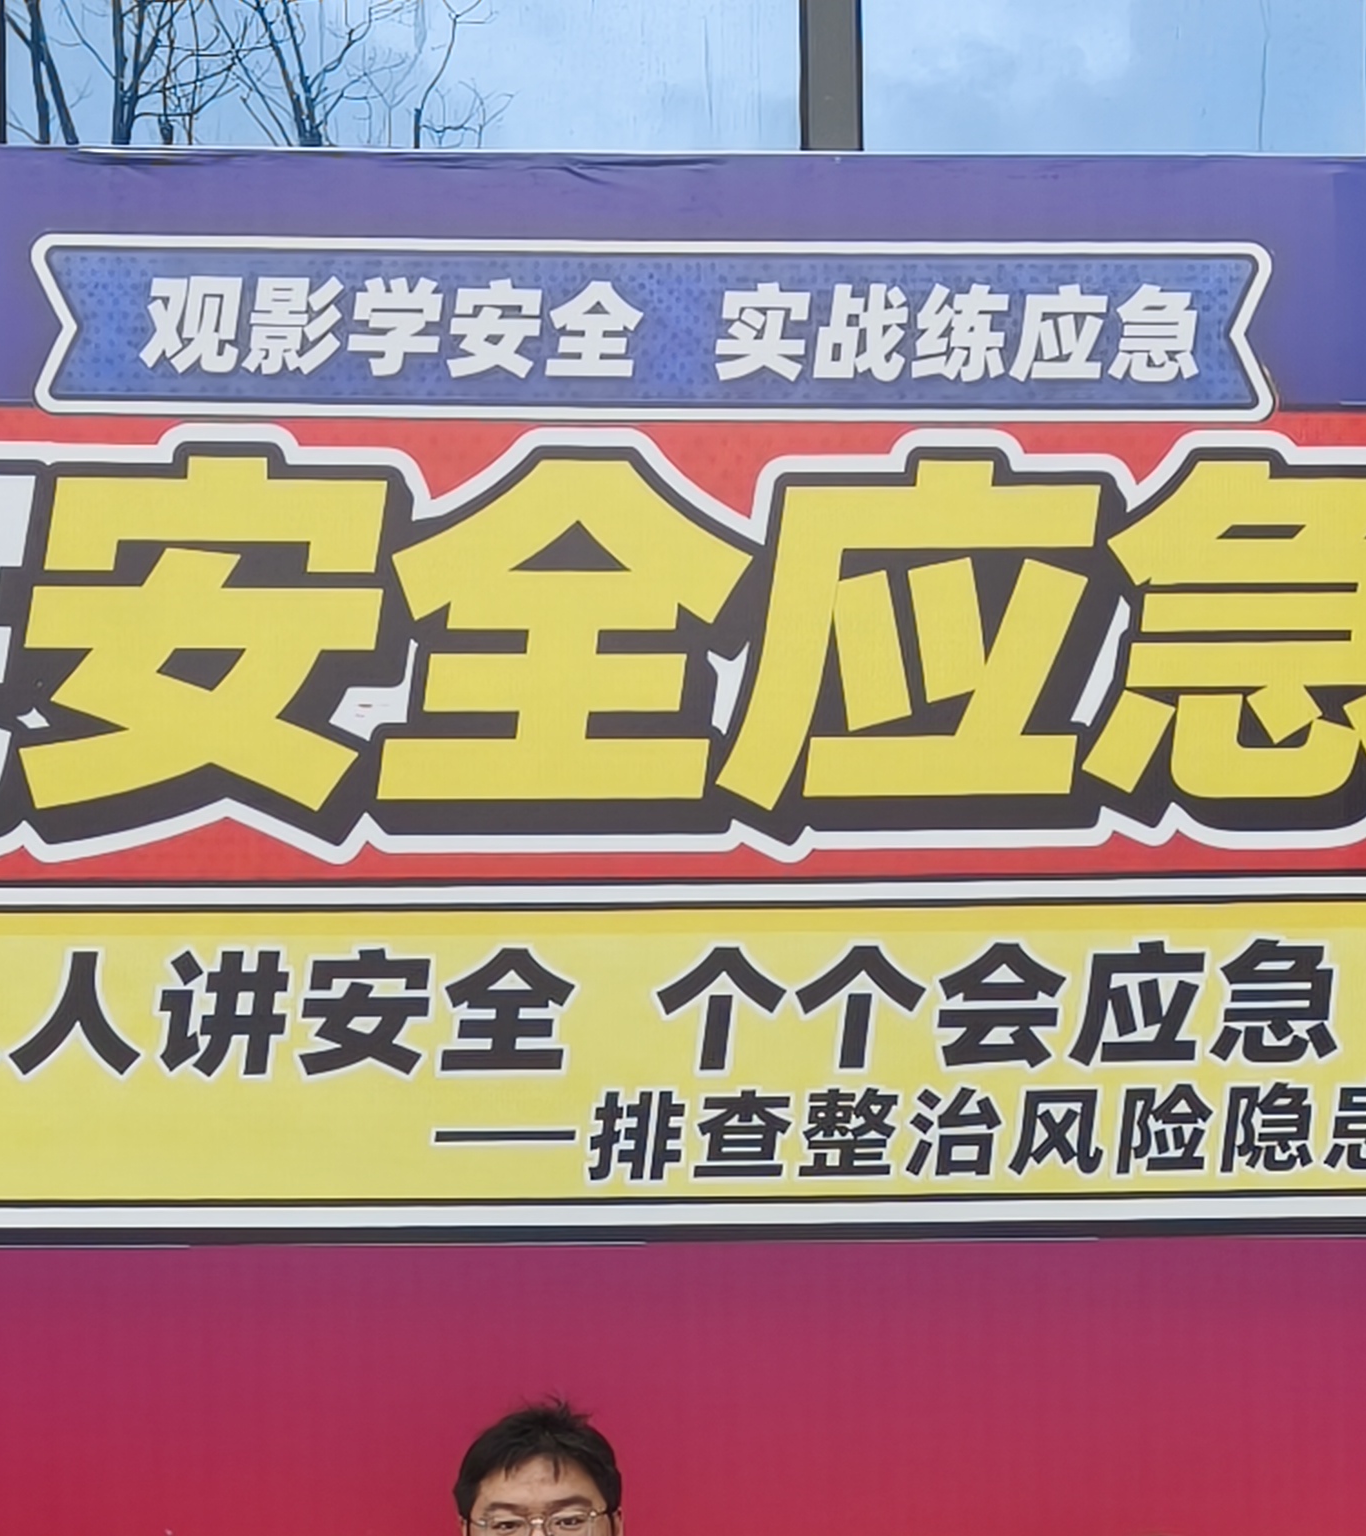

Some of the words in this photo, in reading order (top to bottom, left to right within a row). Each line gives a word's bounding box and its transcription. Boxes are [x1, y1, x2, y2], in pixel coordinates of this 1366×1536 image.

[139, 275, 644, 379] 观影学安全
[714, 281, 1199, 382] 实战练应急
[657, 938, 1337, 1070] 个个会应急
